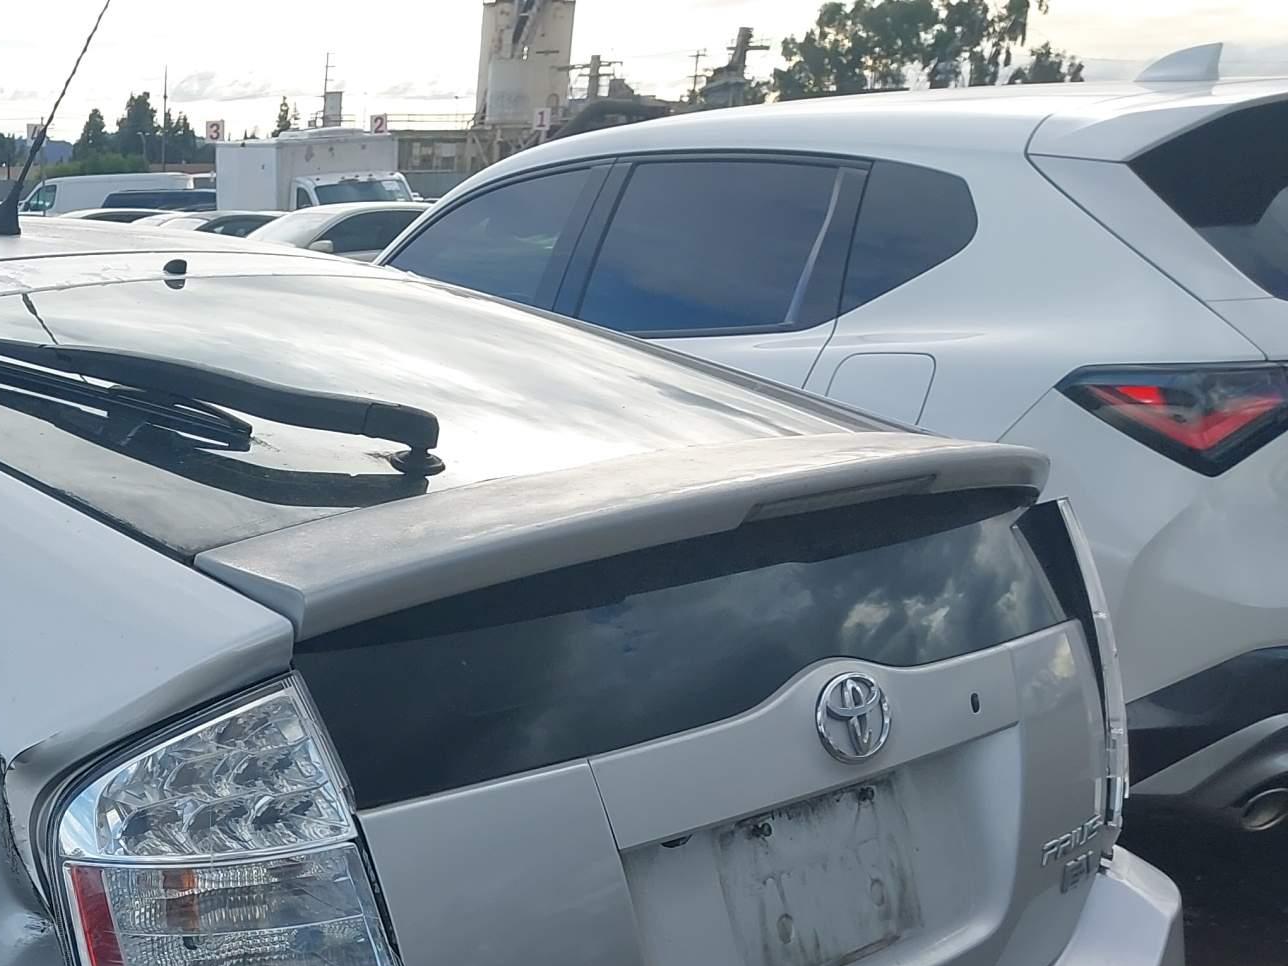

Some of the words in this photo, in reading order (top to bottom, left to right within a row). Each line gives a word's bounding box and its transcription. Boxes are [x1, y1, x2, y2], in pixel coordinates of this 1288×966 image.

[373, 116, 384, 133] 2
[537, 111, 546, 128] 1
[209, 123, 220, 140] 3
